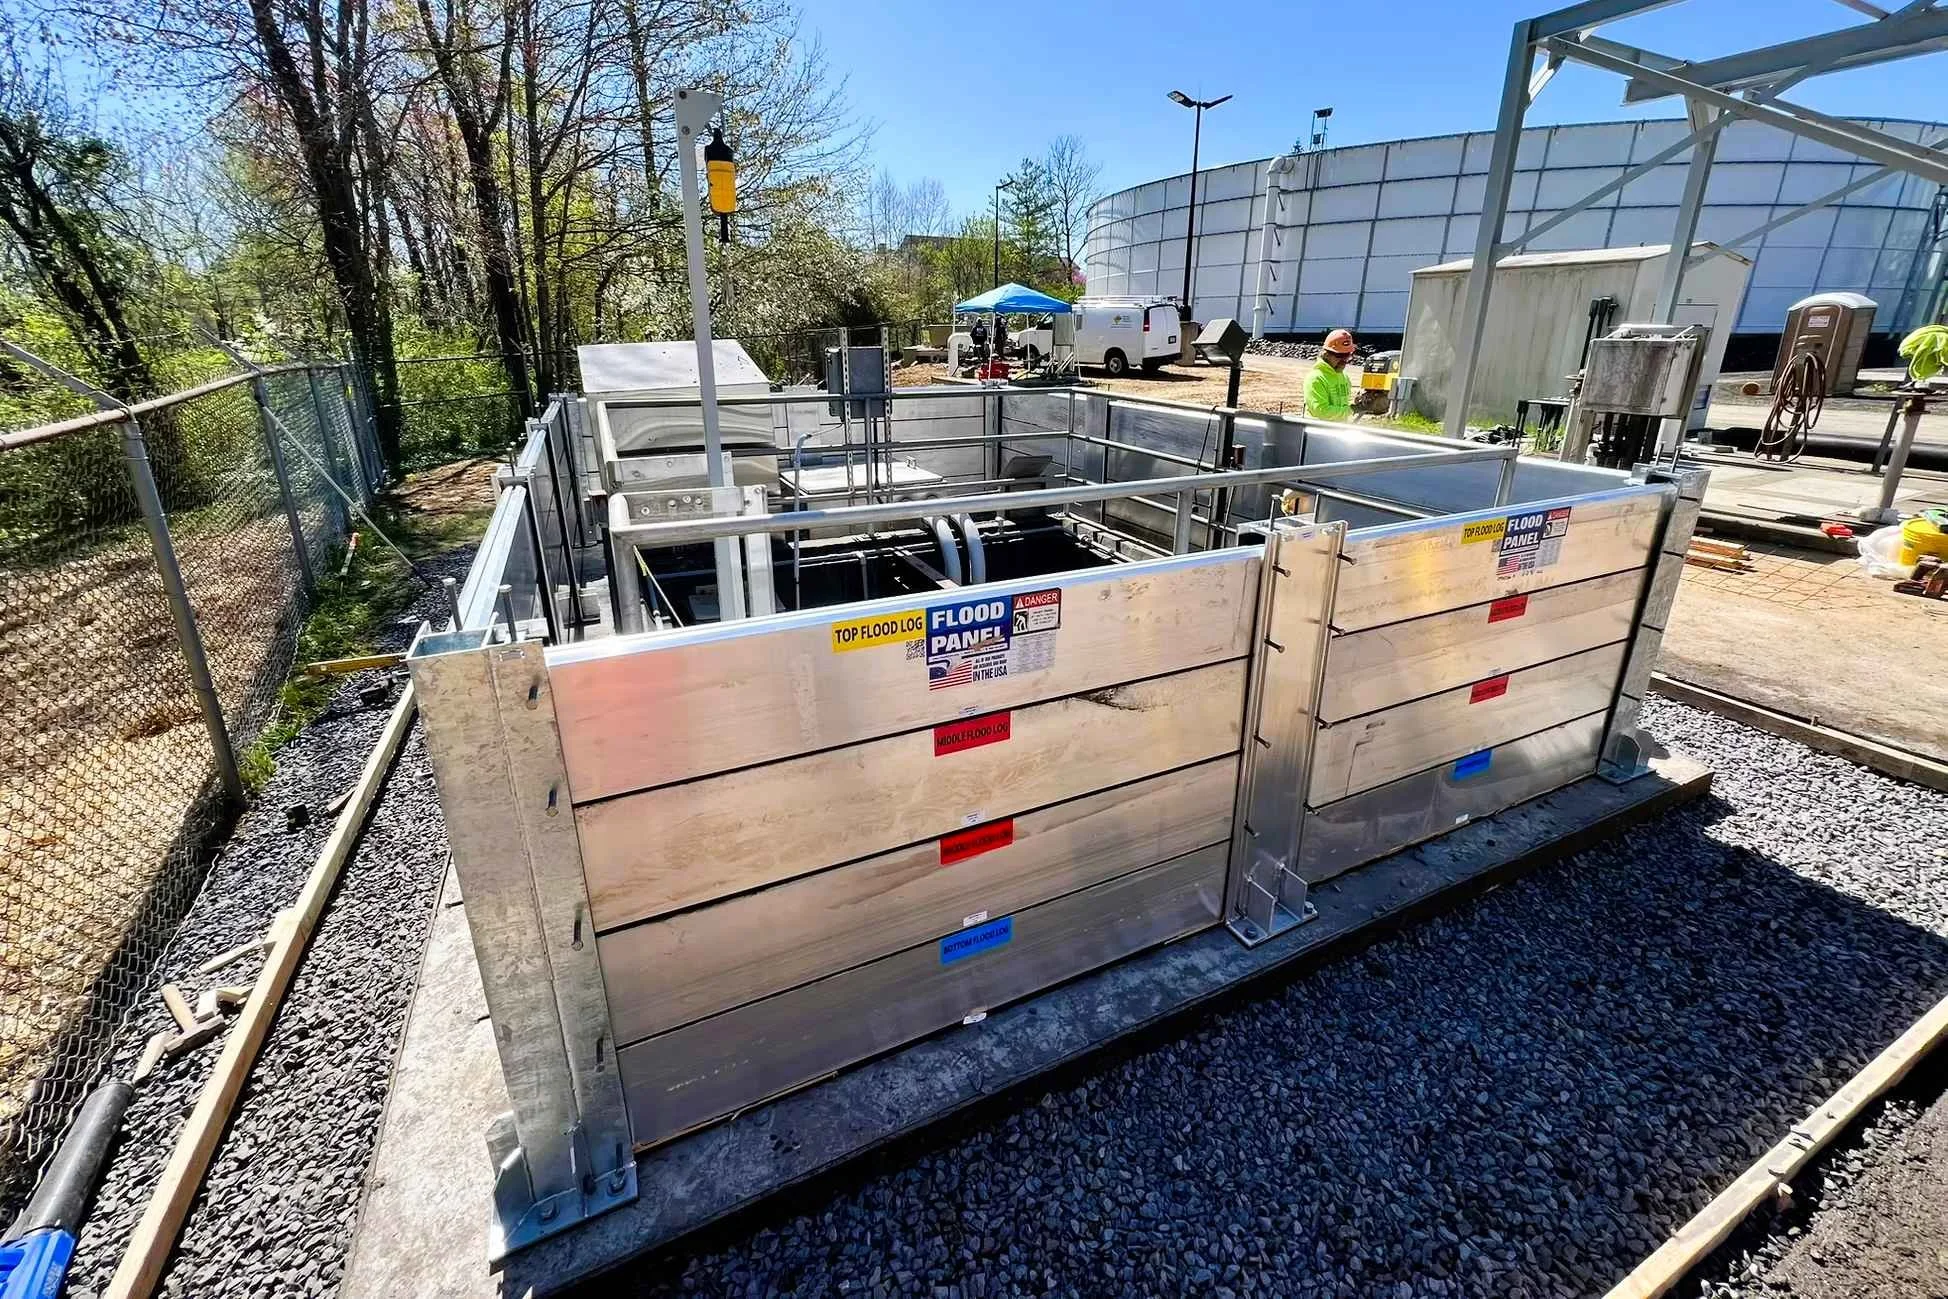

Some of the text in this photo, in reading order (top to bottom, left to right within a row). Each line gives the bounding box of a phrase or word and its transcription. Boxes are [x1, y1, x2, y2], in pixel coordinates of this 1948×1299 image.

[1464, 521, 1505, 539] TOP FLOOD LOG
[1507, 514, 1544, 532] FLOOD
[1503, 532, 1540, 550] PANEL
[1024, 592, 1058, 607] DANGER
[932, 601, 1005, 629] FLOOD
[835, 616, 923, 644] TOP FLOOD LOG
[931, 626, 1005, 655] PANEL
[972, 665, 1008, 681] IN THE USA
[936, 722, 1009, 748] MIDDLE FLOOD LOG
[943, 937, 972, 954] BOTTOM
